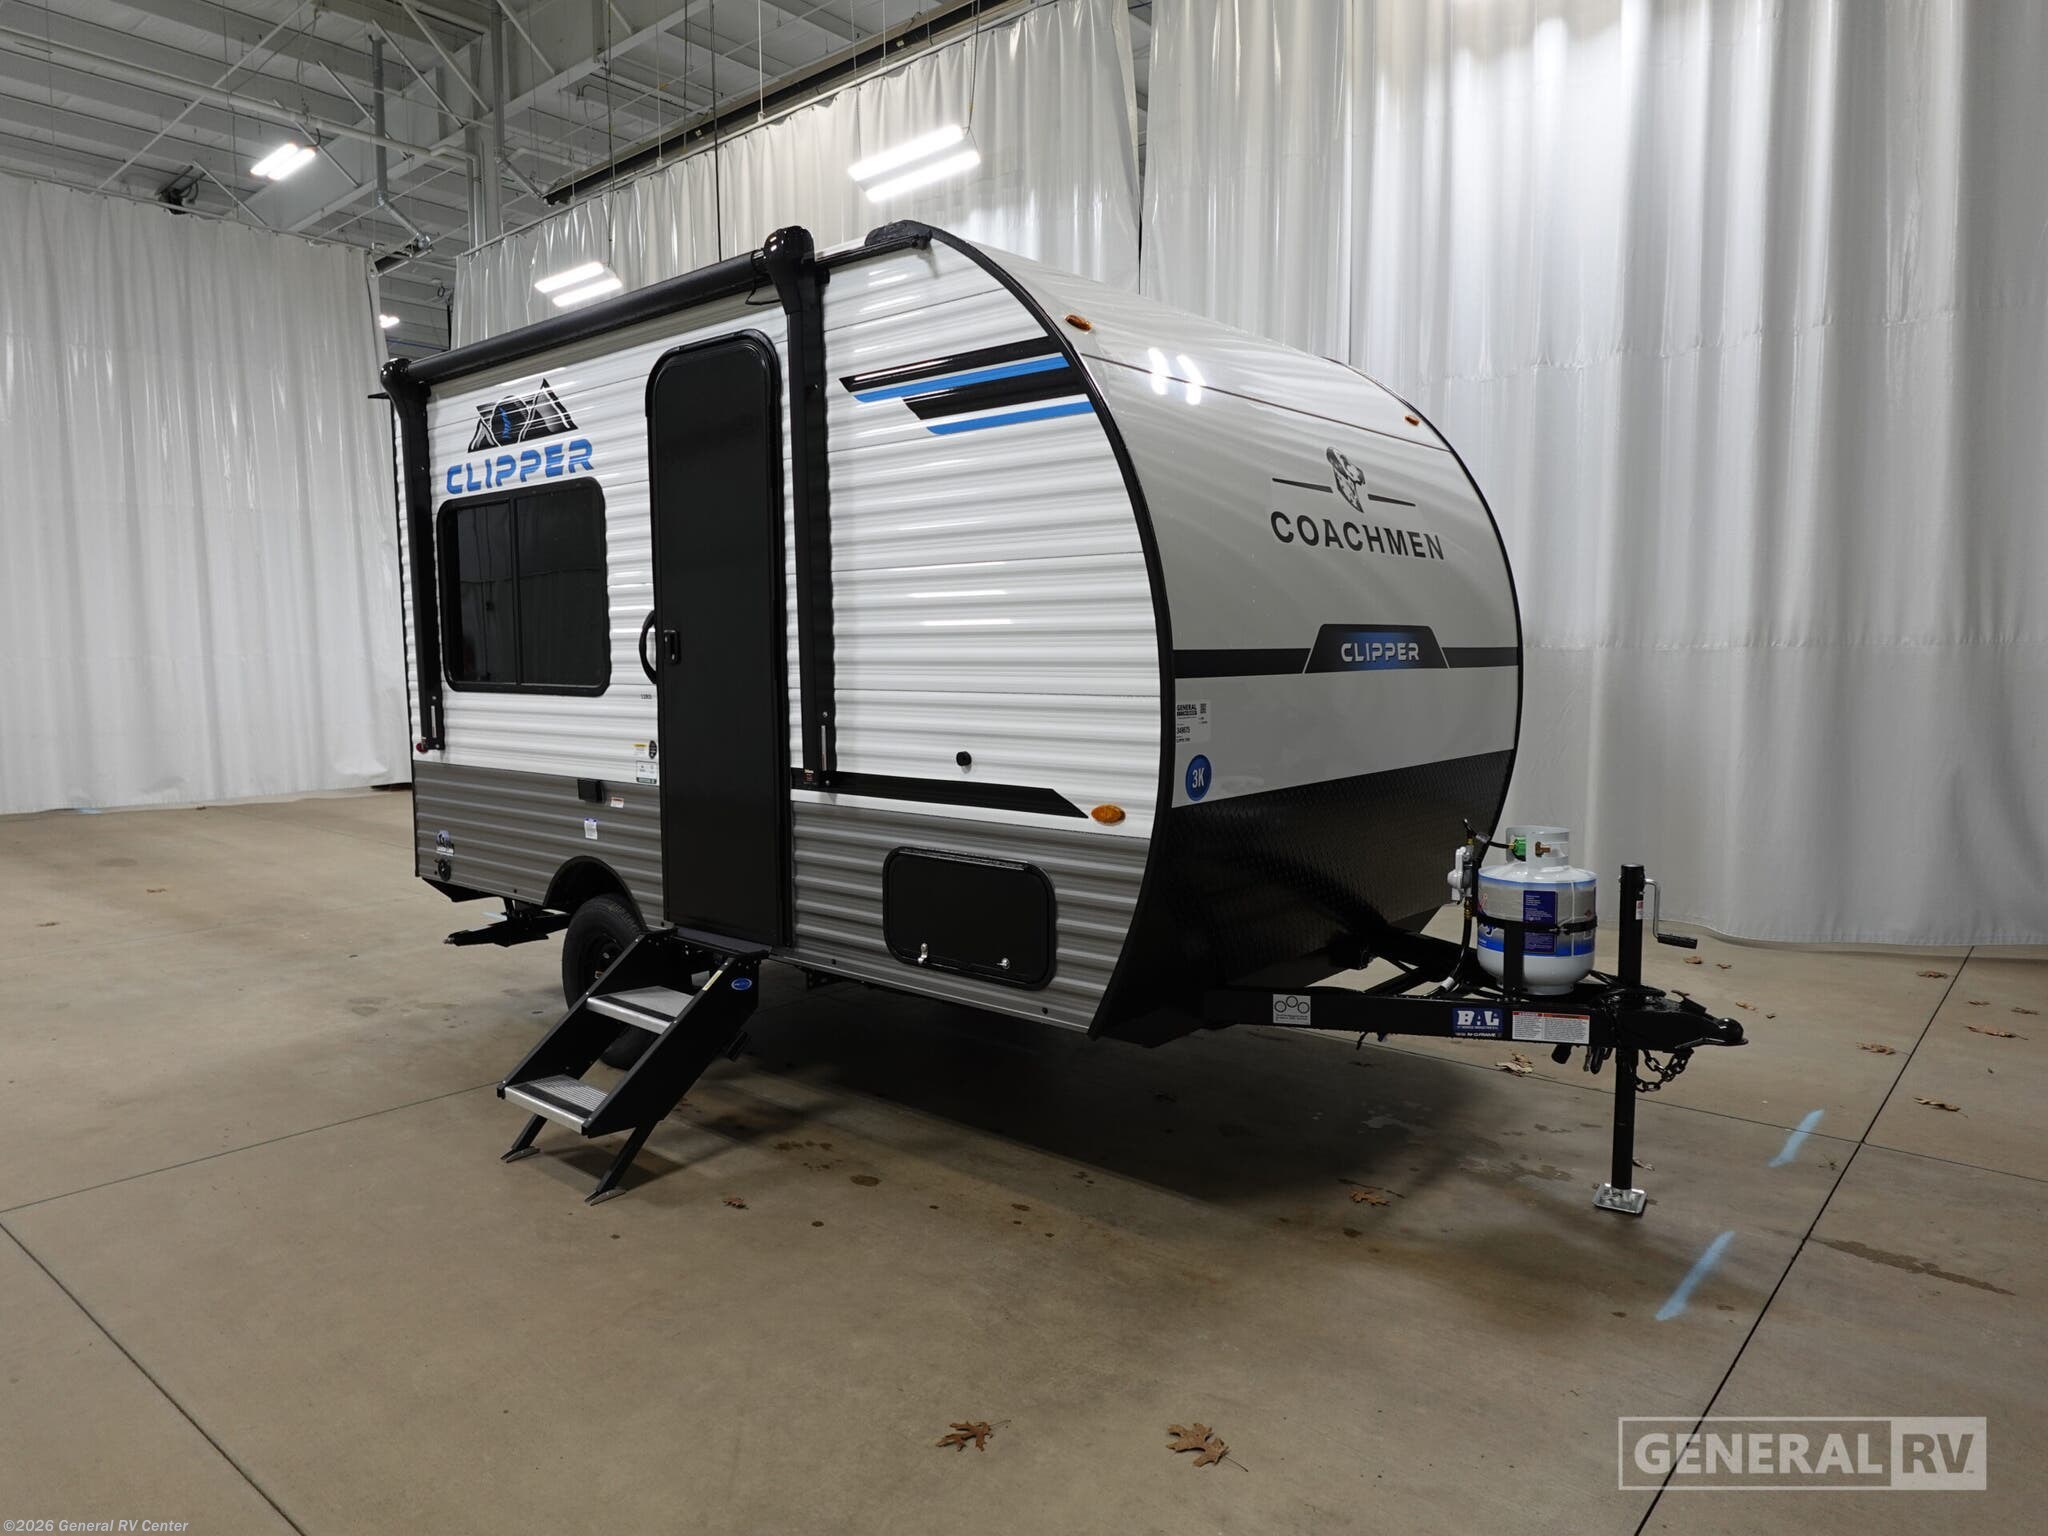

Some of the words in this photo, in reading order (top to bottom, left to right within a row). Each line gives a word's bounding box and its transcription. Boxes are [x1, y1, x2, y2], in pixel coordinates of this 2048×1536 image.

[446, 438, 594, 495] CLIPPER
[1270, 511, 1444, 560] COACHMEN
[1341, 642, 1420, 662] CLIPPER
[1192, 767, 1205, 788] 3K
